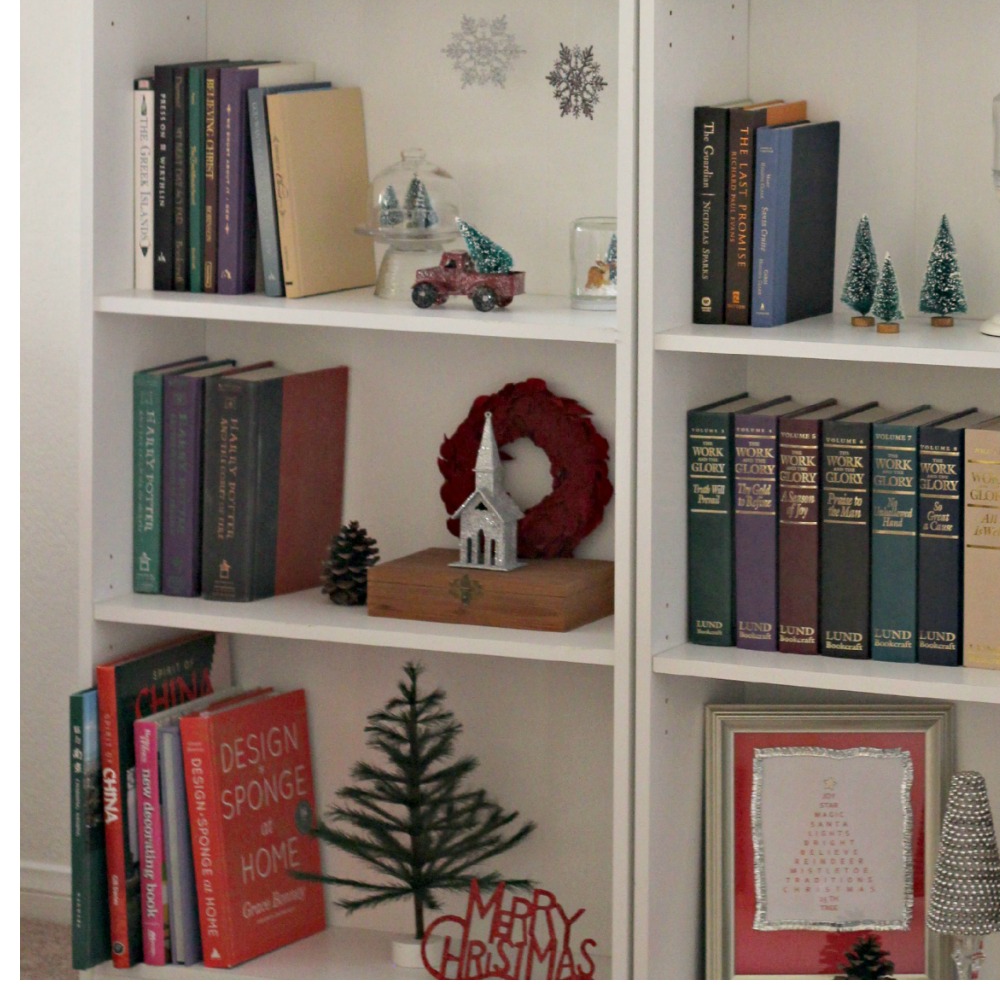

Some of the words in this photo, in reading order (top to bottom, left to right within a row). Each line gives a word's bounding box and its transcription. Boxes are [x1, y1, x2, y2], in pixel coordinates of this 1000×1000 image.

[206, 78, 214, 137] BELIEVING
[140, 118, 148, 141] THE
[160, 124, 166, 138] ON
[703, 122, 715, 142] The
[740, 127, 749, 155] THE
[139, 145, 151, 187] GREEK
[205, 139, 214, 180] CHRIST
[702, 145, 714, 188] Guardian
[739, 163, 748, 197] LAST
[139, 191, 151, 241] ISLANDS
[702, 201, 711, 244] NICHOLAS
[737, 204, 747, 268] PROMISE
[701, 247, 710, 280] SPARKS
[145, 410, 155, 471] HARRY
[229, 418, 238, 479] HARRY
[692, 447, 724, 457] WORK
[736, 448, 774, 458] WORK
[780, 455, 816, 467] WORK
[826, 456, 864, 468] WORK
[691, 463, 725, 473] GLORY
[735, 464, 775, 474] GLORY
[874, 459, 912, 470] WORK
[921, 463, 957, 475] WORK
[779, 471, 817, 483] GLORY
[825, 473, 865, 484] GLORY
[874, 476, 913, 487] GLORY
[920, 480, 959, 491] GLORY
[144, 474, 154, 532] POTTER
[226, 482, 236, 540] POTTER
[933, 502, 943, 512] So
[927, 511, 950, 523] Great
[696, 620, 723, 629] LUND
[739, 621, 772, 632] LUND
[779, 625, 815, 636] LUND
[874, 629, 912, 640] LUND
[779, 635, 816, 644] Bookcraft
[825, 631, 863, 642] LUND
[874, 638, 912, 648] Bookcraft
[919, 630, 956, 641] LUND
[919, 639, 956, 650] Bookcraft
[826, 641, 863, 651] Bookcraft
[135, 667, 214, 719] CHINA
[220, 722, 299, 773] DESIGN
[142, 769, 153, 798] new
[221, 765, 307, 820] SPONGE
[103, 767, 119, 824] CHINA
[141, 802, 156, 879] decorating
[241, 836, 300, 885] HOME
[202, 879, 214, 892] at
[147, 883, 158, 917] book
[206, 897, 218, 937] HOME
[465, 877, 586, 947] MERRY
[421, 915, 597, 980] CHRISTMAS
